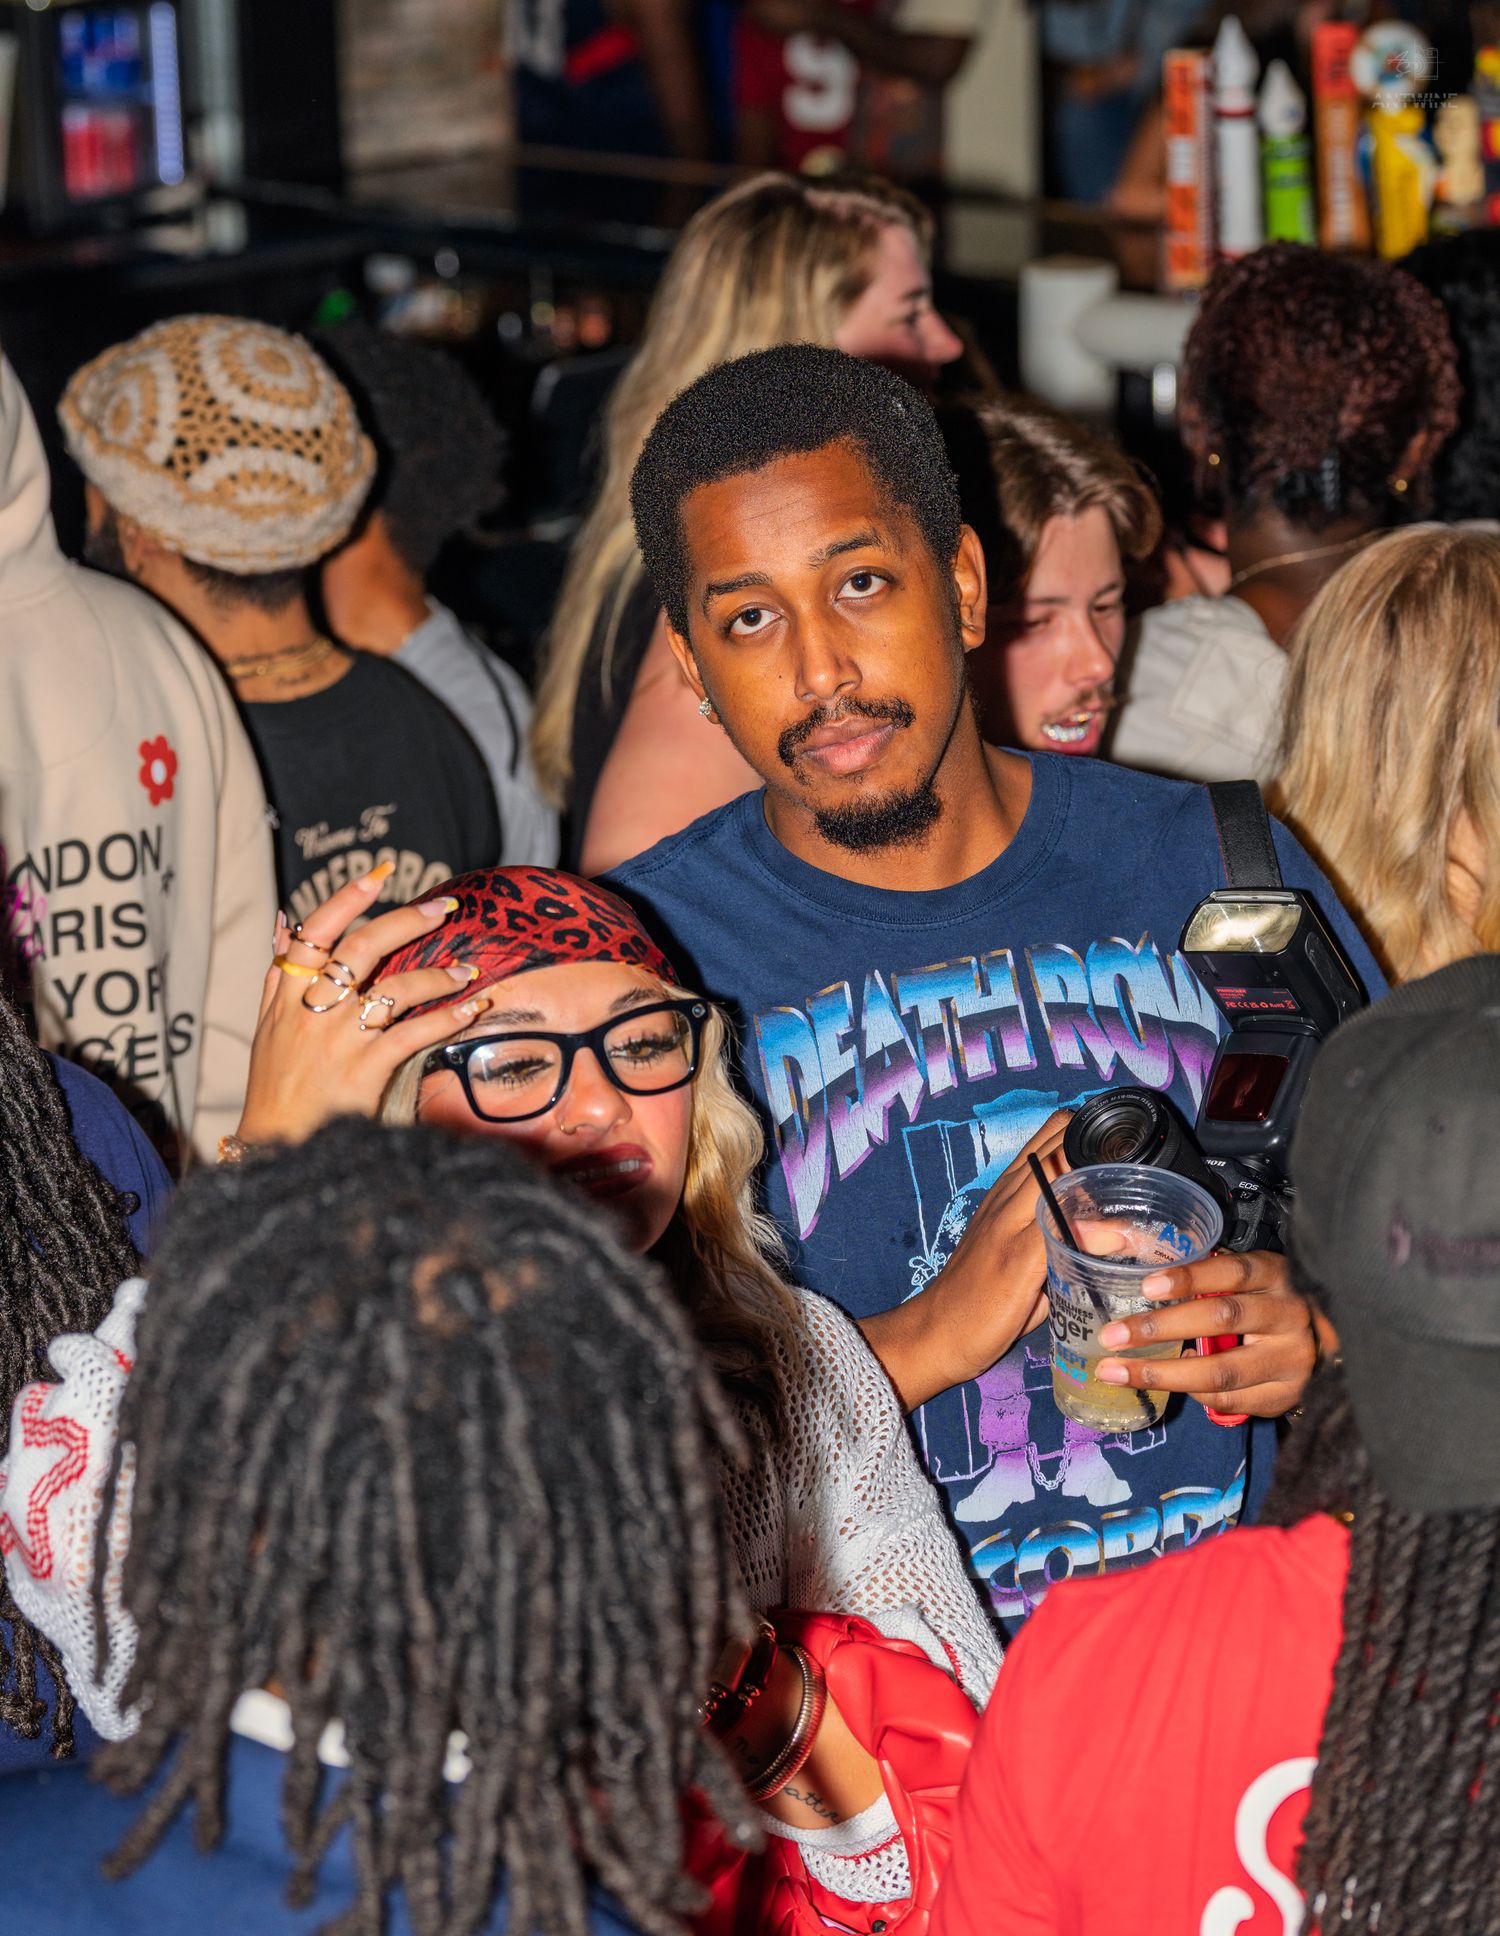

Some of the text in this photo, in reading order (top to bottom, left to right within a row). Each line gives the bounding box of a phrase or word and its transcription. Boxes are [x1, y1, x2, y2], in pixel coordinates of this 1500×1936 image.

[18, 902, 147, 960] ARIS
[753, 930, 1220, 1240] DEATH ROW
[1238, 1181, 1259, 1191] EOS
[1048, 1305, 1094, 1344] oger
